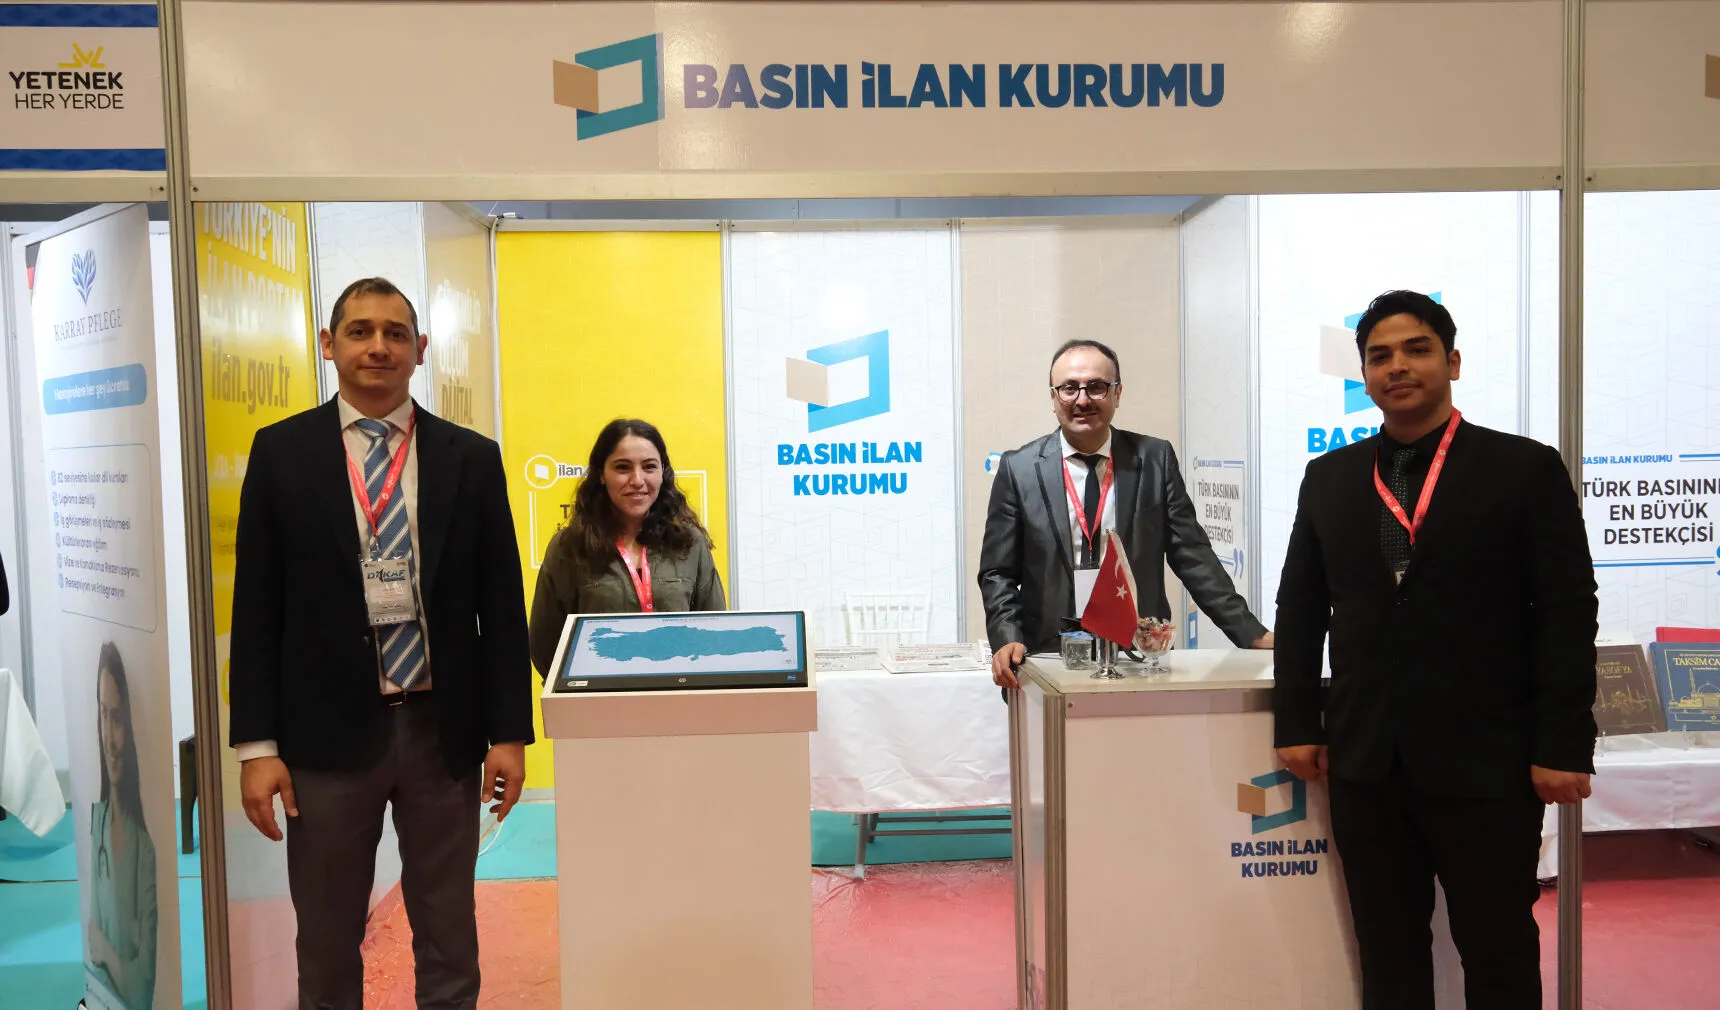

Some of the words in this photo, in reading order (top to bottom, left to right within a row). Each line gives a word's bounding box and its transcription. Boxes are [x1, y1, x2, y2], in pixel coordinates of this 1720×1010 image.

[8, 71, 124, 90] YETENEK
[682, 63, 849, 109] BASIN
[998, 63, 1225, 108] KURUMU
[15, 93, 55, 109] HER
[58, 93, 124, 109] YERDE
[54, 317, 86, 342] KARRAY
[88, 308, 123, 334] PFLEGE
[777, 443, 856, 465] BASIN
[1633, 454, 1673, 463] KURUMU
[793, 472, 907, 496] KURUMU
[1198, 478, 1212, 498] TÜRK
[1582, 477, 1631, 498] TÜRK
[1205, 504, 1213, 519] EN
[1213, 501, 1232, 522] BÜYÜK
[1610, 504, 1635, 521] EN
[1641, 499, 1708, 521] BÜYÜK
[1604, 522, 1714, 545] DESTEKÇİSİ
[1708, 657, 1720, 666] CA
[1231, 840, 1284, 857] BASIN
[1241, 860, 1318, 878] KURUMU
